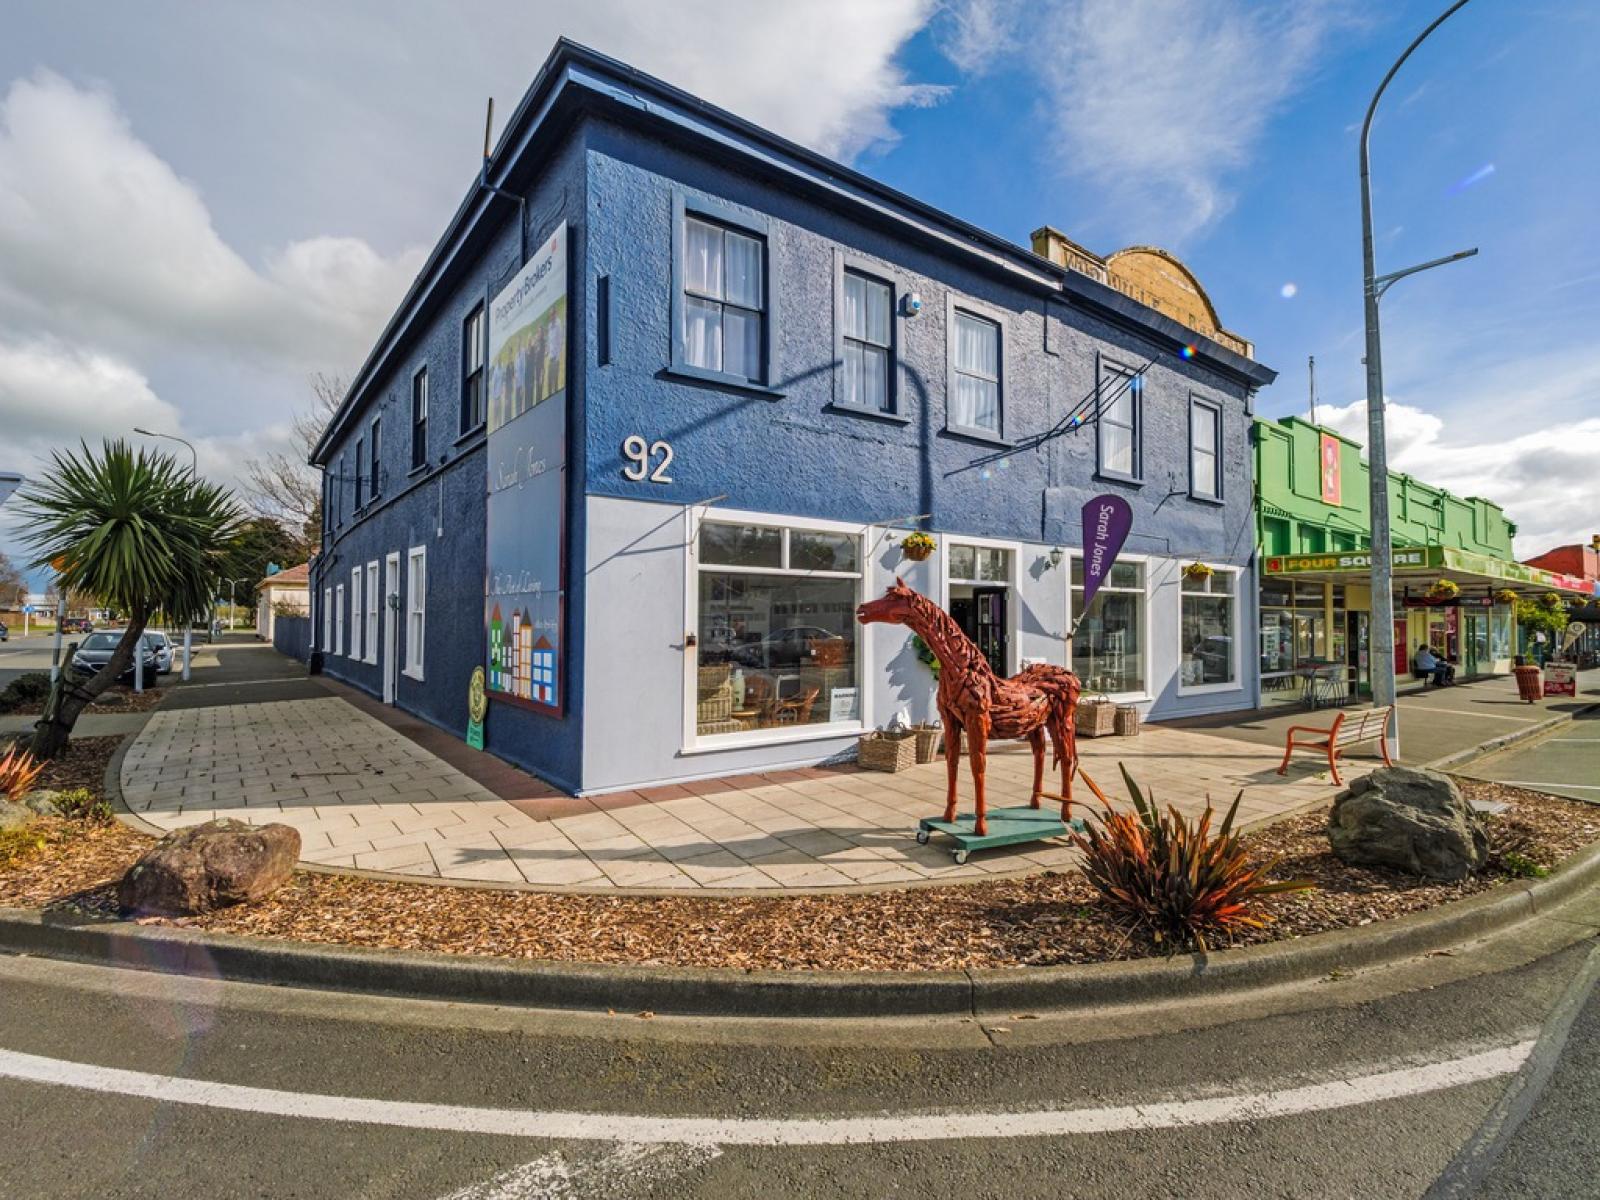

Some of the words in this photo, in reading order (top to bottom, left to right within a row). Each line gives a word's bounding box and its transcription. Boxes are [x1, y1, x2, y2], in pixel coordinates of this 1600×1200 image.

[623, 435, 673, 483] 92
[1096, 504, 1115, 540] Sarah
[1090, 542, 1108, 577] Jones
[1288, 558, 1337, 569] FOUR
[1339, 553, 1421, 567] SQRE
